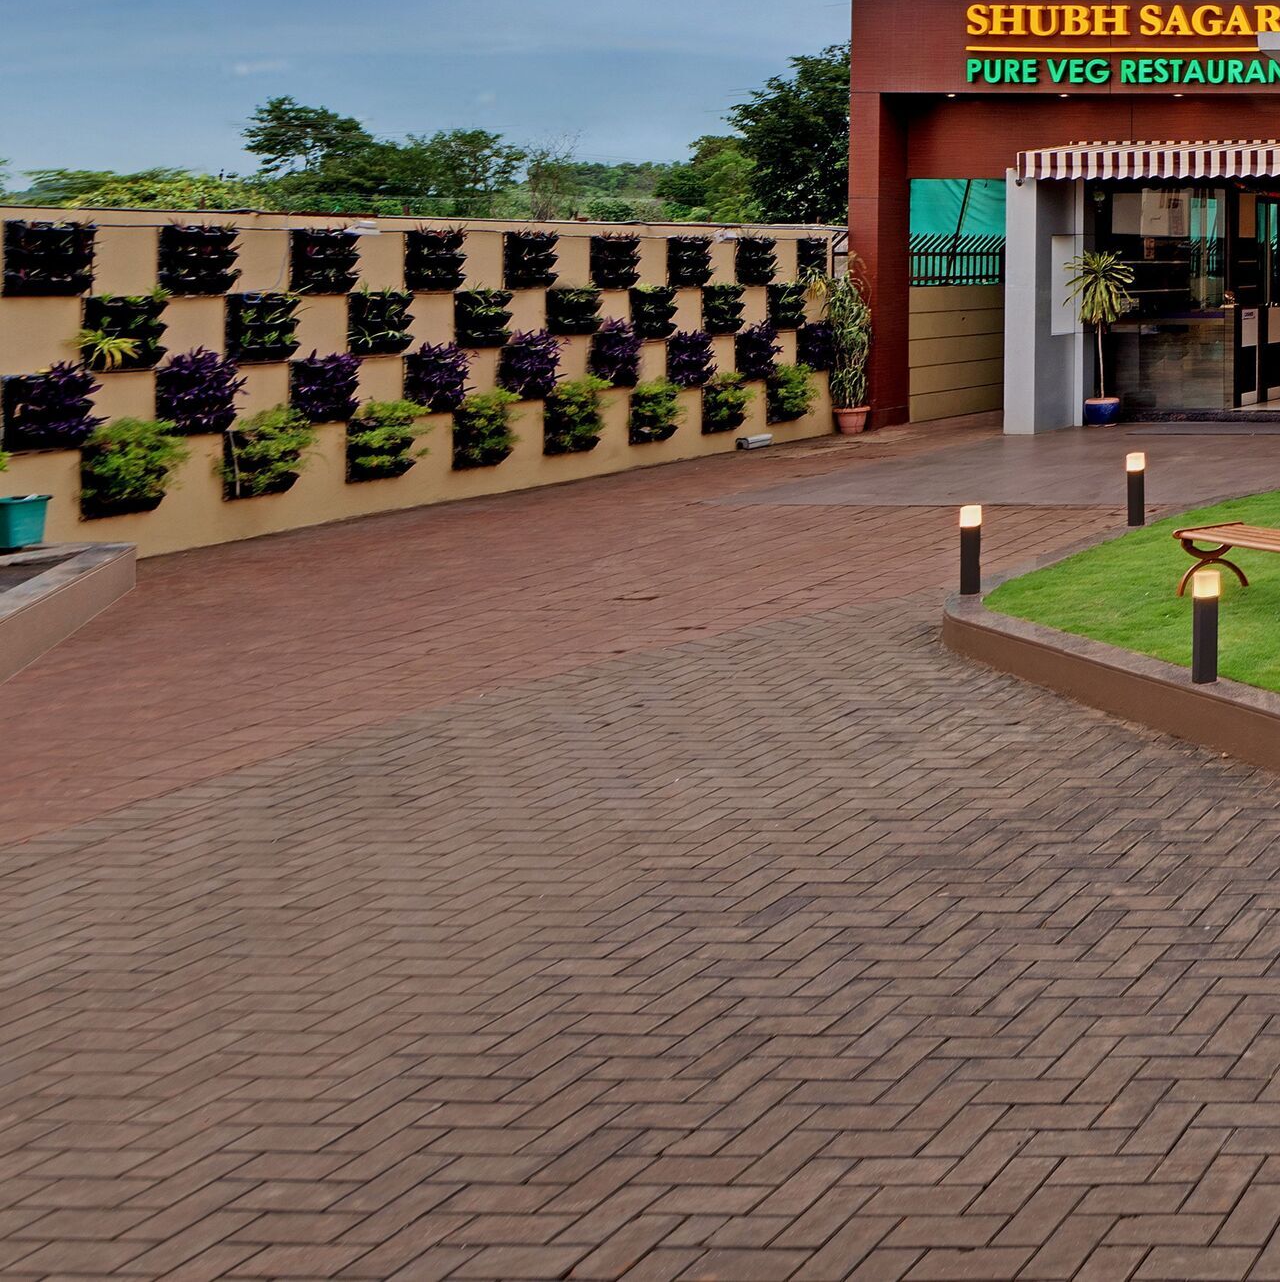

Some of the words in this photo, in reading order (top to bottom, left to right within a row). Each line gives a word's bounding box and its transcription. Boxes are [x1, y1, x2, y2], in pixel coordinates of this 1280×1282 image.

[966, 4, 1131, 37] SHUBH
[966, 58, 1038, 84] PURE
[1046, 59, 1111, 84] VEG
